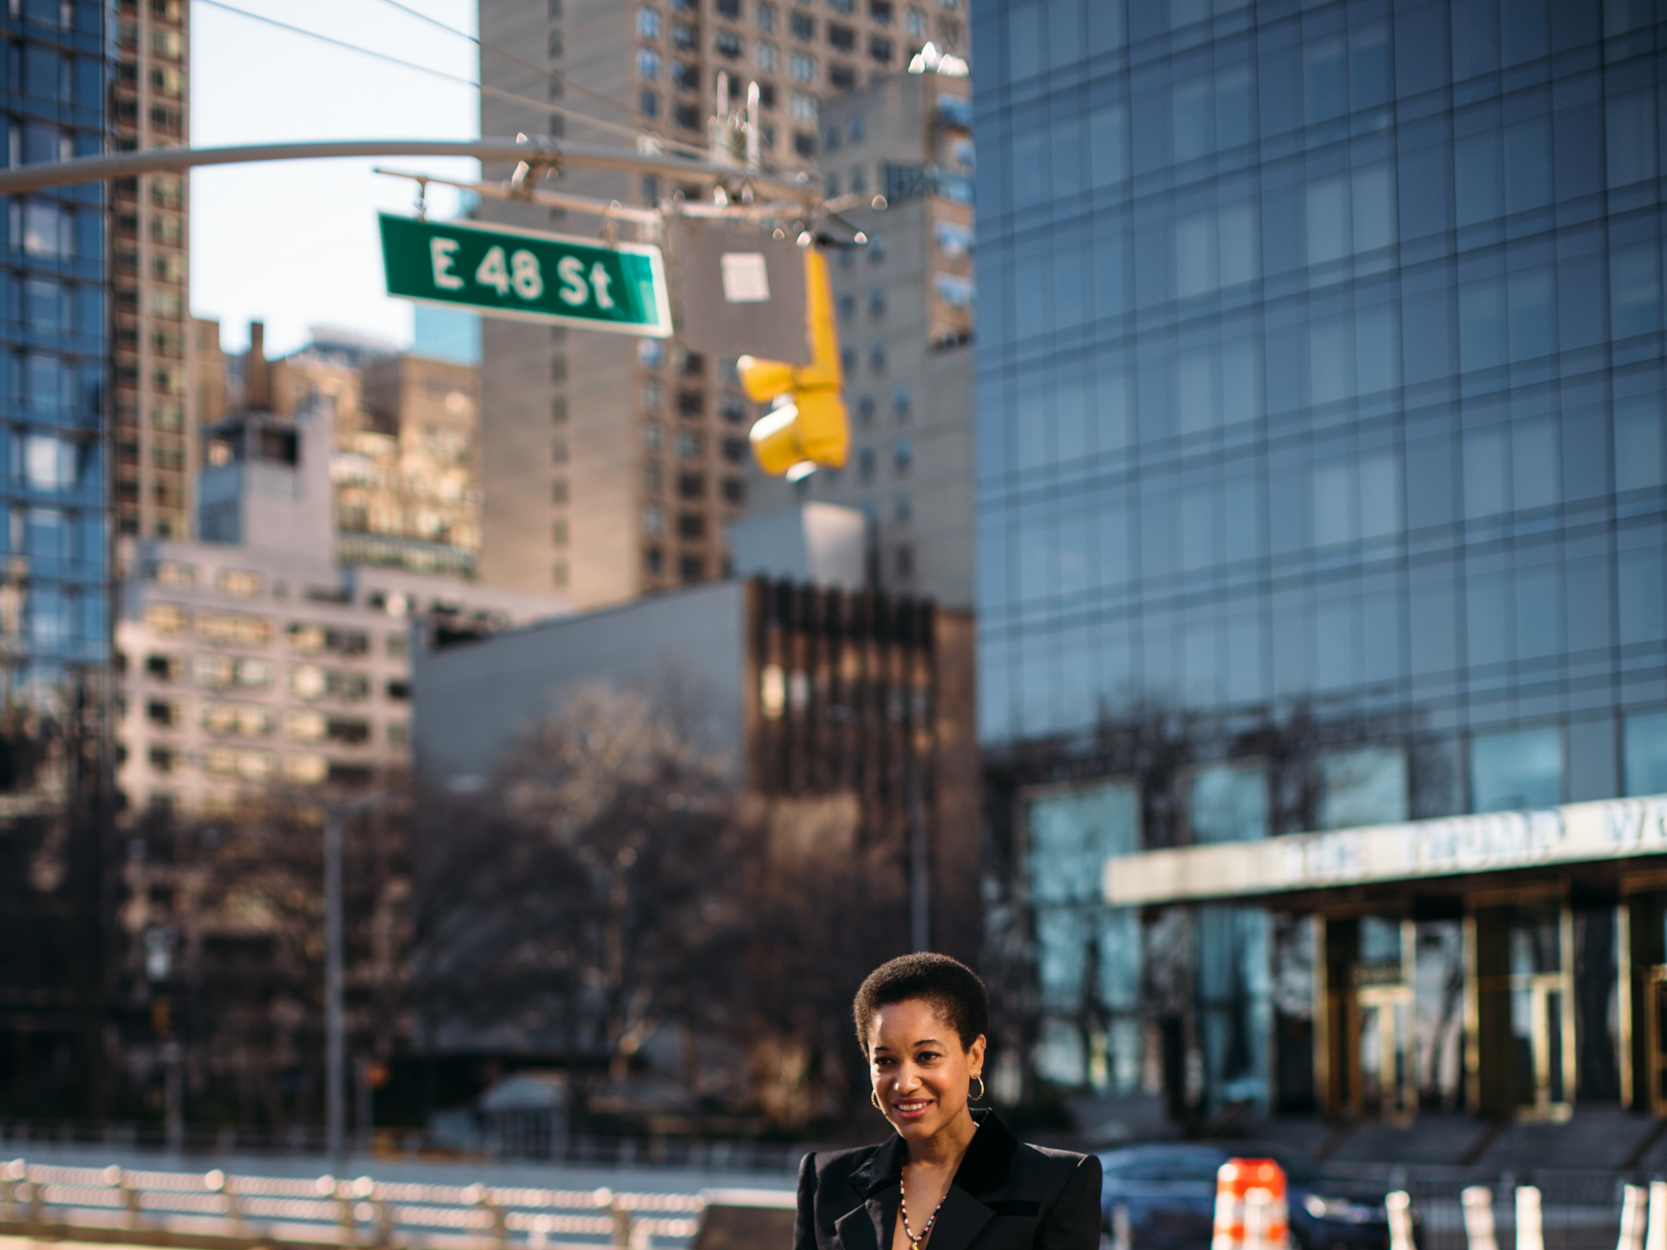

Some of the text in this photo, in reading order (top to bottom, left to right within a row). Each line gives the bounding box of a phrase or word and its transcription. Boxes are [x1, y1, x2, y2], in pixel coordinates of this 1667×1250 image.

[430, 236, 615, 310] E 48 St
[1404, 808, 1567, 876] TRUMP
